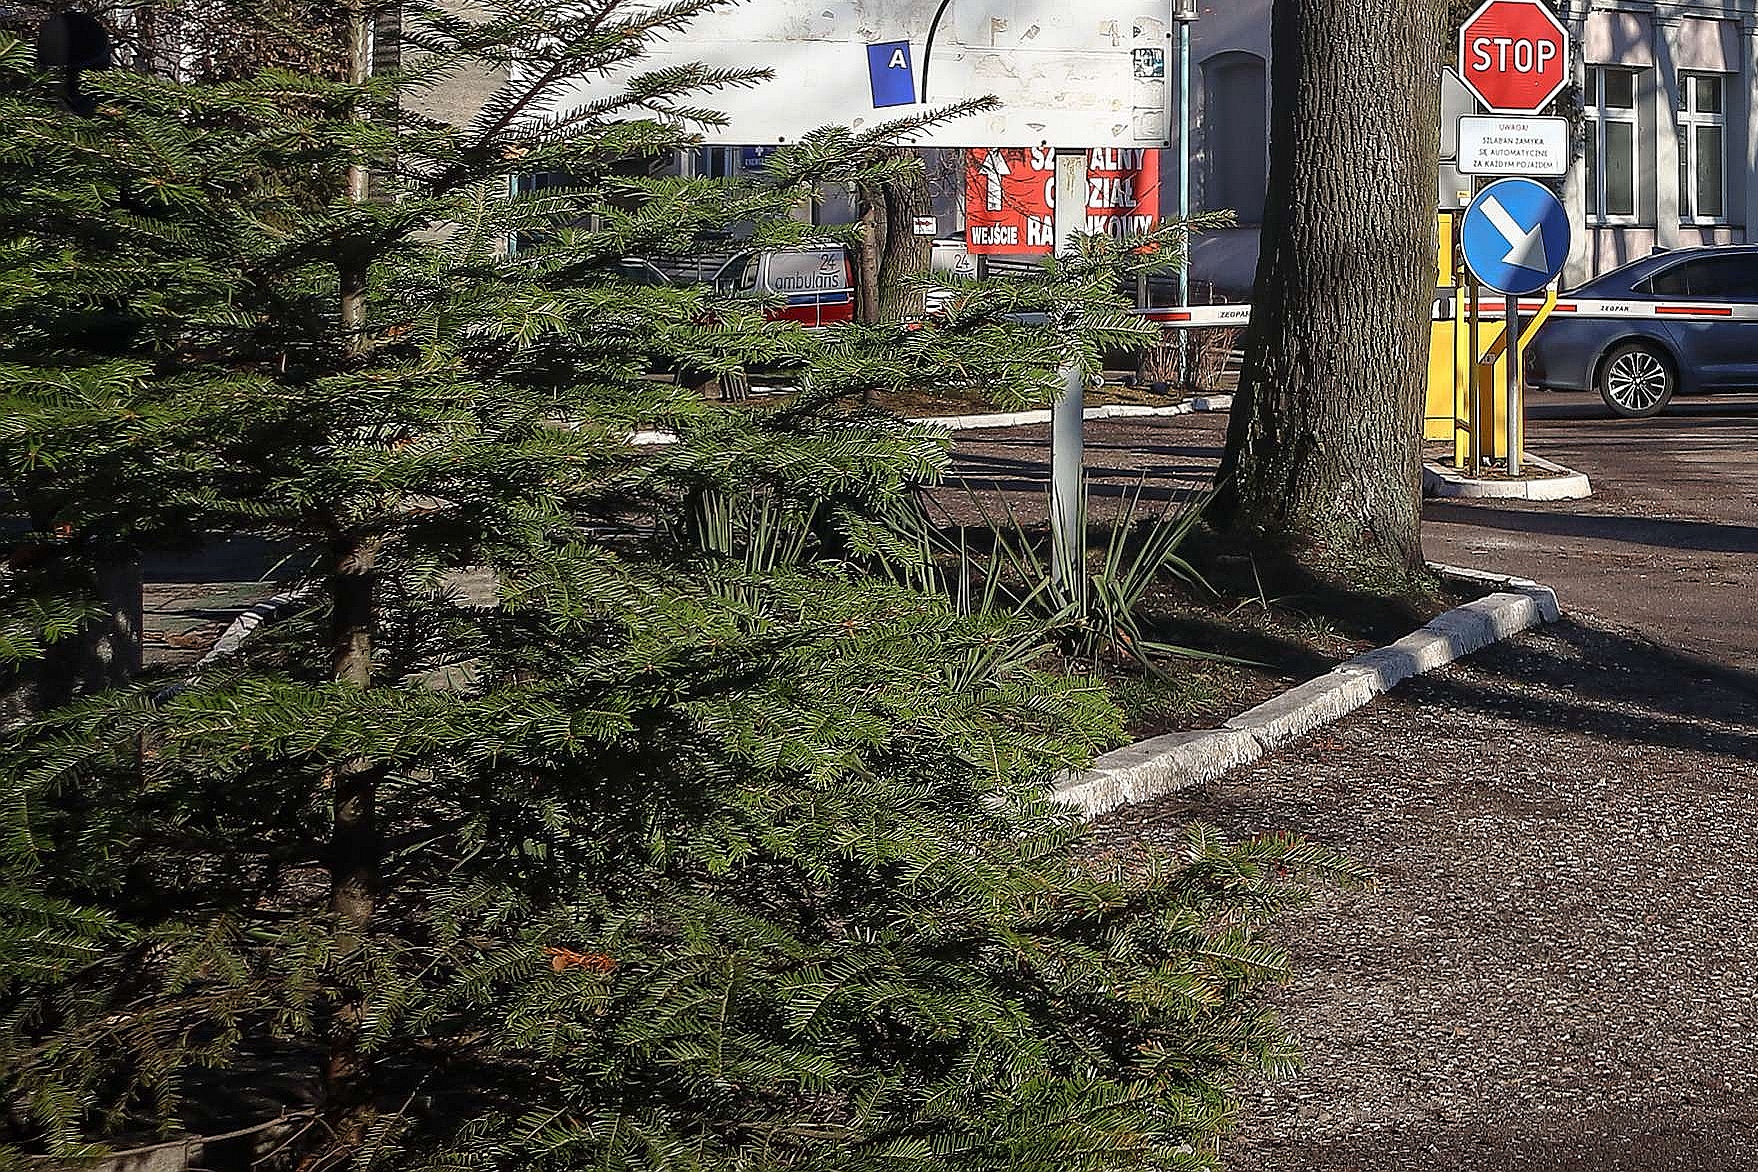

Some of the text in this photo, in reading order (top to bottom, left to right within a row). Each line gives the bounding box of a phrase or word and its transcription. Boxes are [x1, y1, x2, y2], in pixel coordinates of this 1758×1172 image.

[887, 49, 908, 69] A
[1471, 37, 1557, 74] STOP
[1030, 146, 1145, 171] SZALNY
[1044, 176, 1137, 208] OZIAŁ
[971, 222, 1019, 245] WEJŚCIE
[820, 253, 837, 271] 24
[953, 253, 971, 269] 24
[774, 270, 839, 289] ambulans
